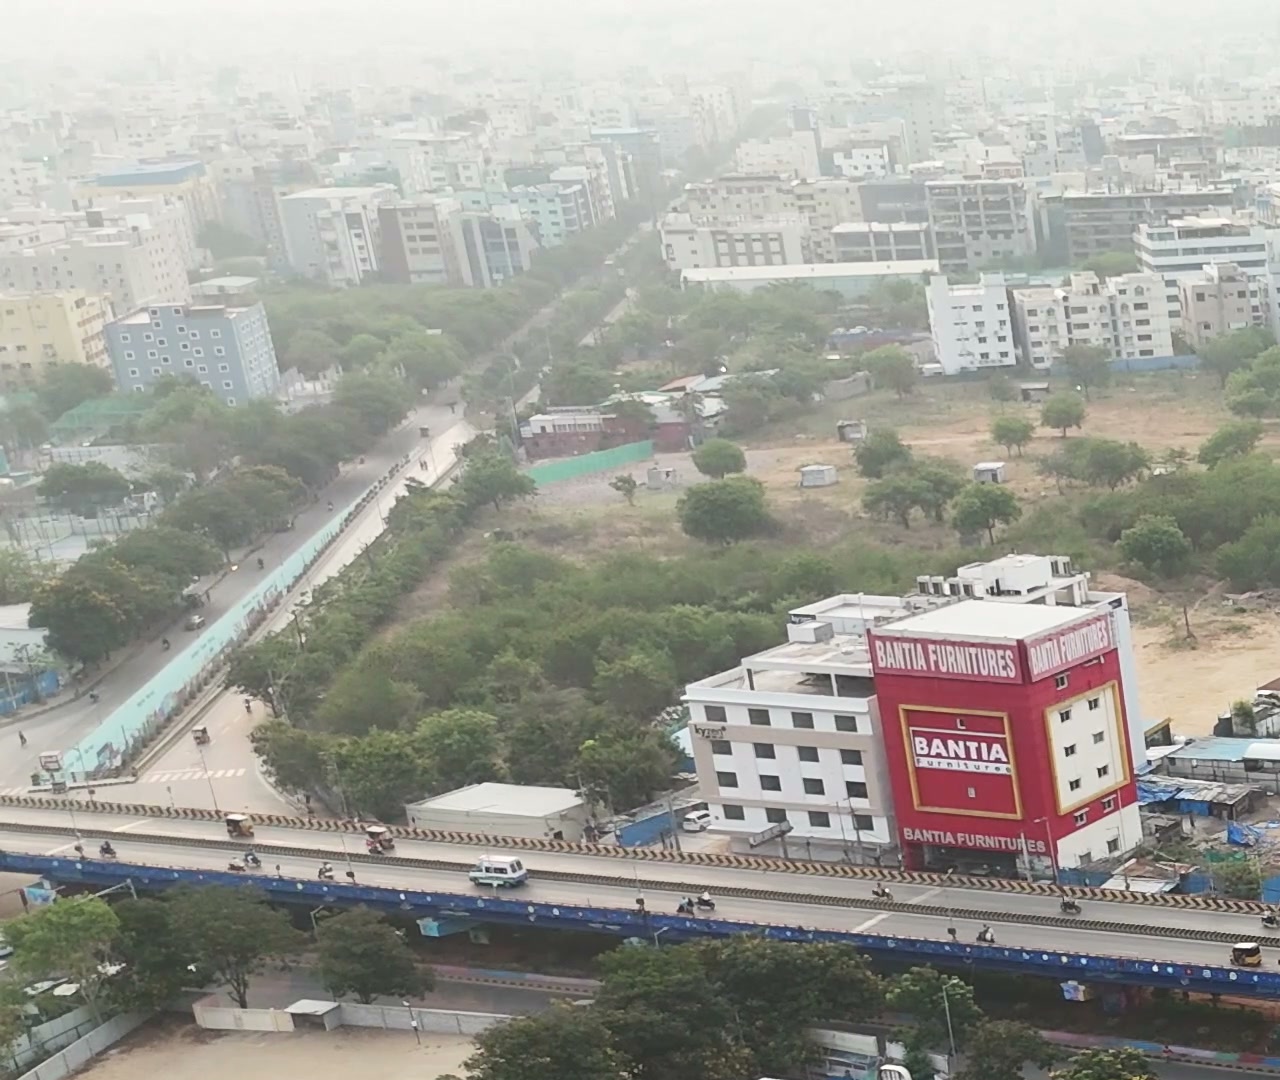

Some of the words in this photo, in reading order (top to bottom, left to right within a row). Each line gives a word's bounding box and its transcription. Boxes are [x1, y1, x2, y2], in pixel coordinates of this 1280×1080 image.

[875, 640, 927, 671] BANTIA
[928, 643, 1017, 678] FURNITURES
[1029, 640, 1060, 676] BANTIA
[1060, 620, 1108, 666] FURNITURES
[914, 736, 1008, 762] BANTIA
[903, 827, 955, 845] BANTIA
[957, 832, 1046, 853] FURNITURES
